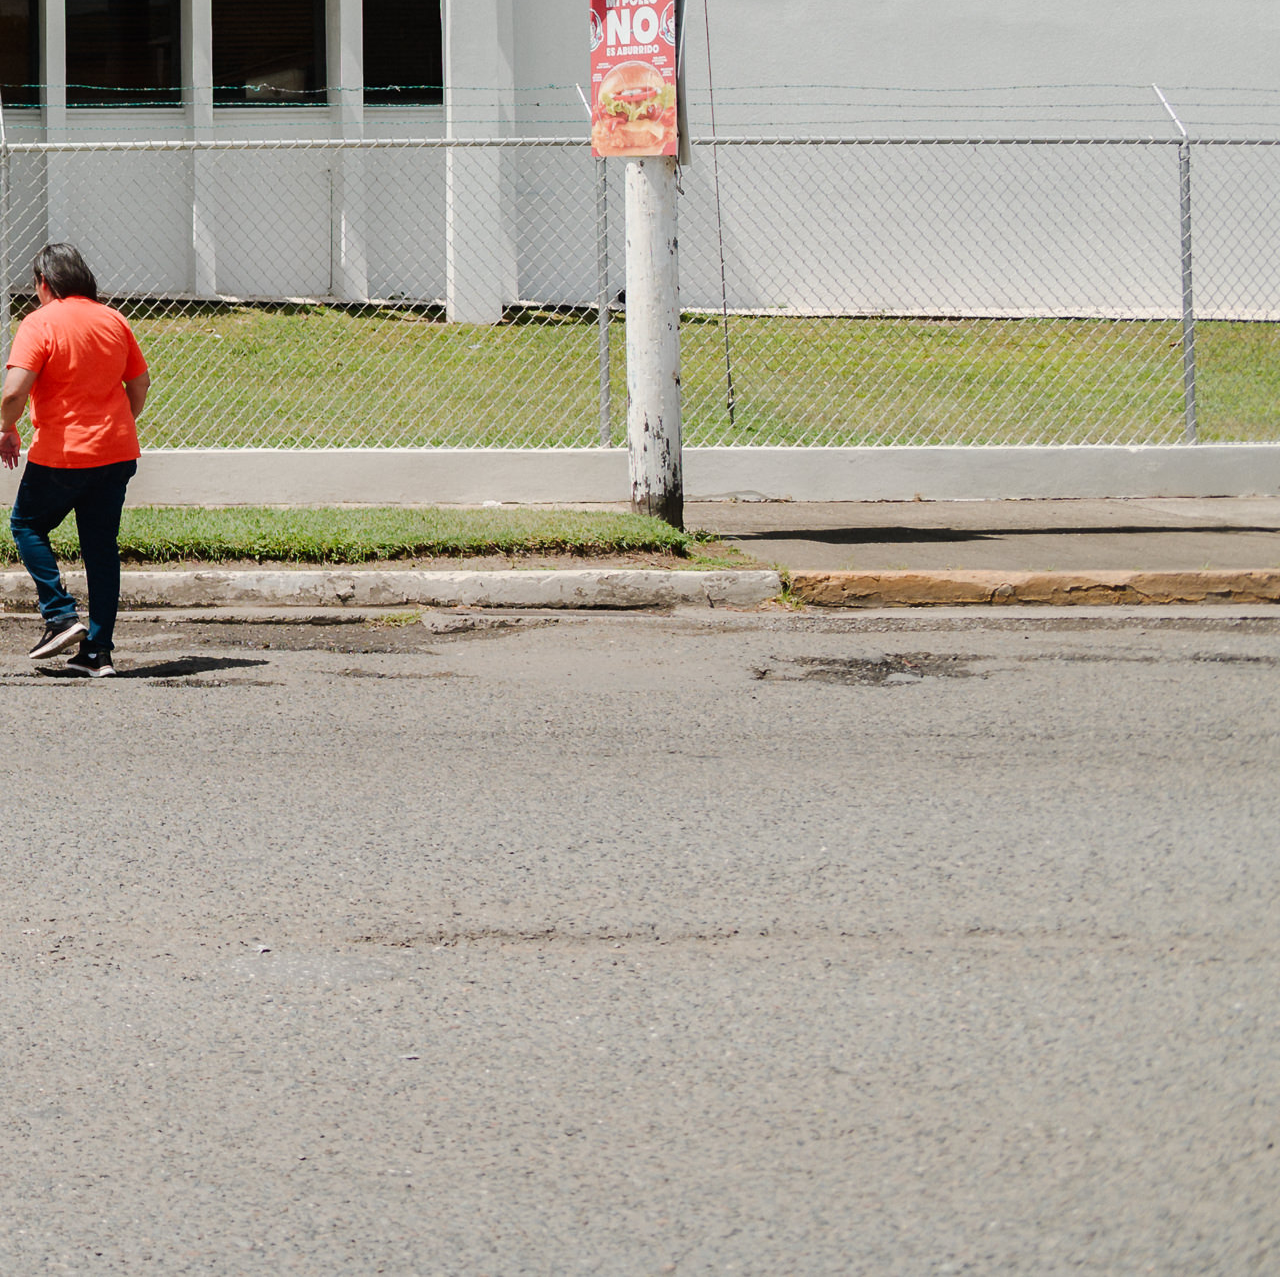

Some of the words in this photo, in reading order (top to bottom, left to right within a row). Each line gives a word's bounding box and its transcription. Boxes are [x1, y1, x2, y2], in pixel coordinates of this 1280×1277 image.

[606, 5, 659, 46] NO
[606, 47, 617, 56] ES
[616, 44, 660, 56] ABURRIDO
